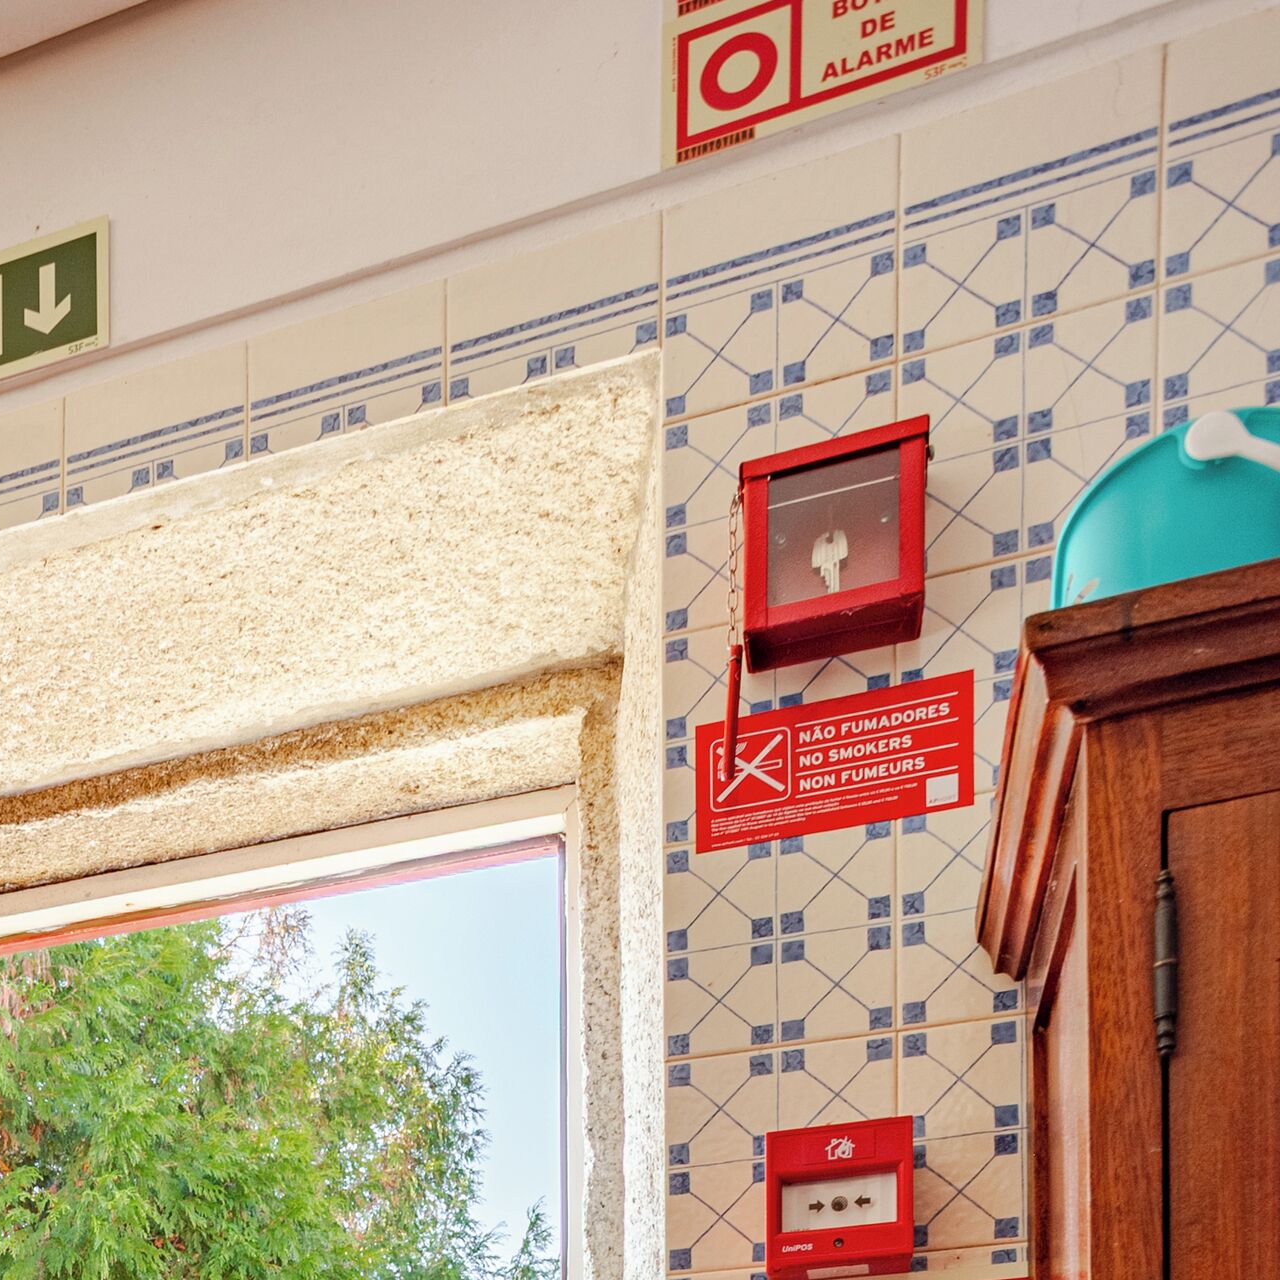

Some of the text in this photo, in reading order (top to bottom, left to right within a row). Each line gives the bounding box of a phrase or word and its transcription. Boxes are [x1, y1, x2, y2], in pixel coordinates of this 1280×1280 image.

[860, 10, 895, 39] DE
[821, 27, 934, 82] ALARME
[799, 702, 950, 744] NÃO FUMADORES
[799, 734, 912, 768] NO SMOKERS
[799, 756, 925, 792] NON FUMEURS
[782, 1243, 813, 1253] UniPOS
